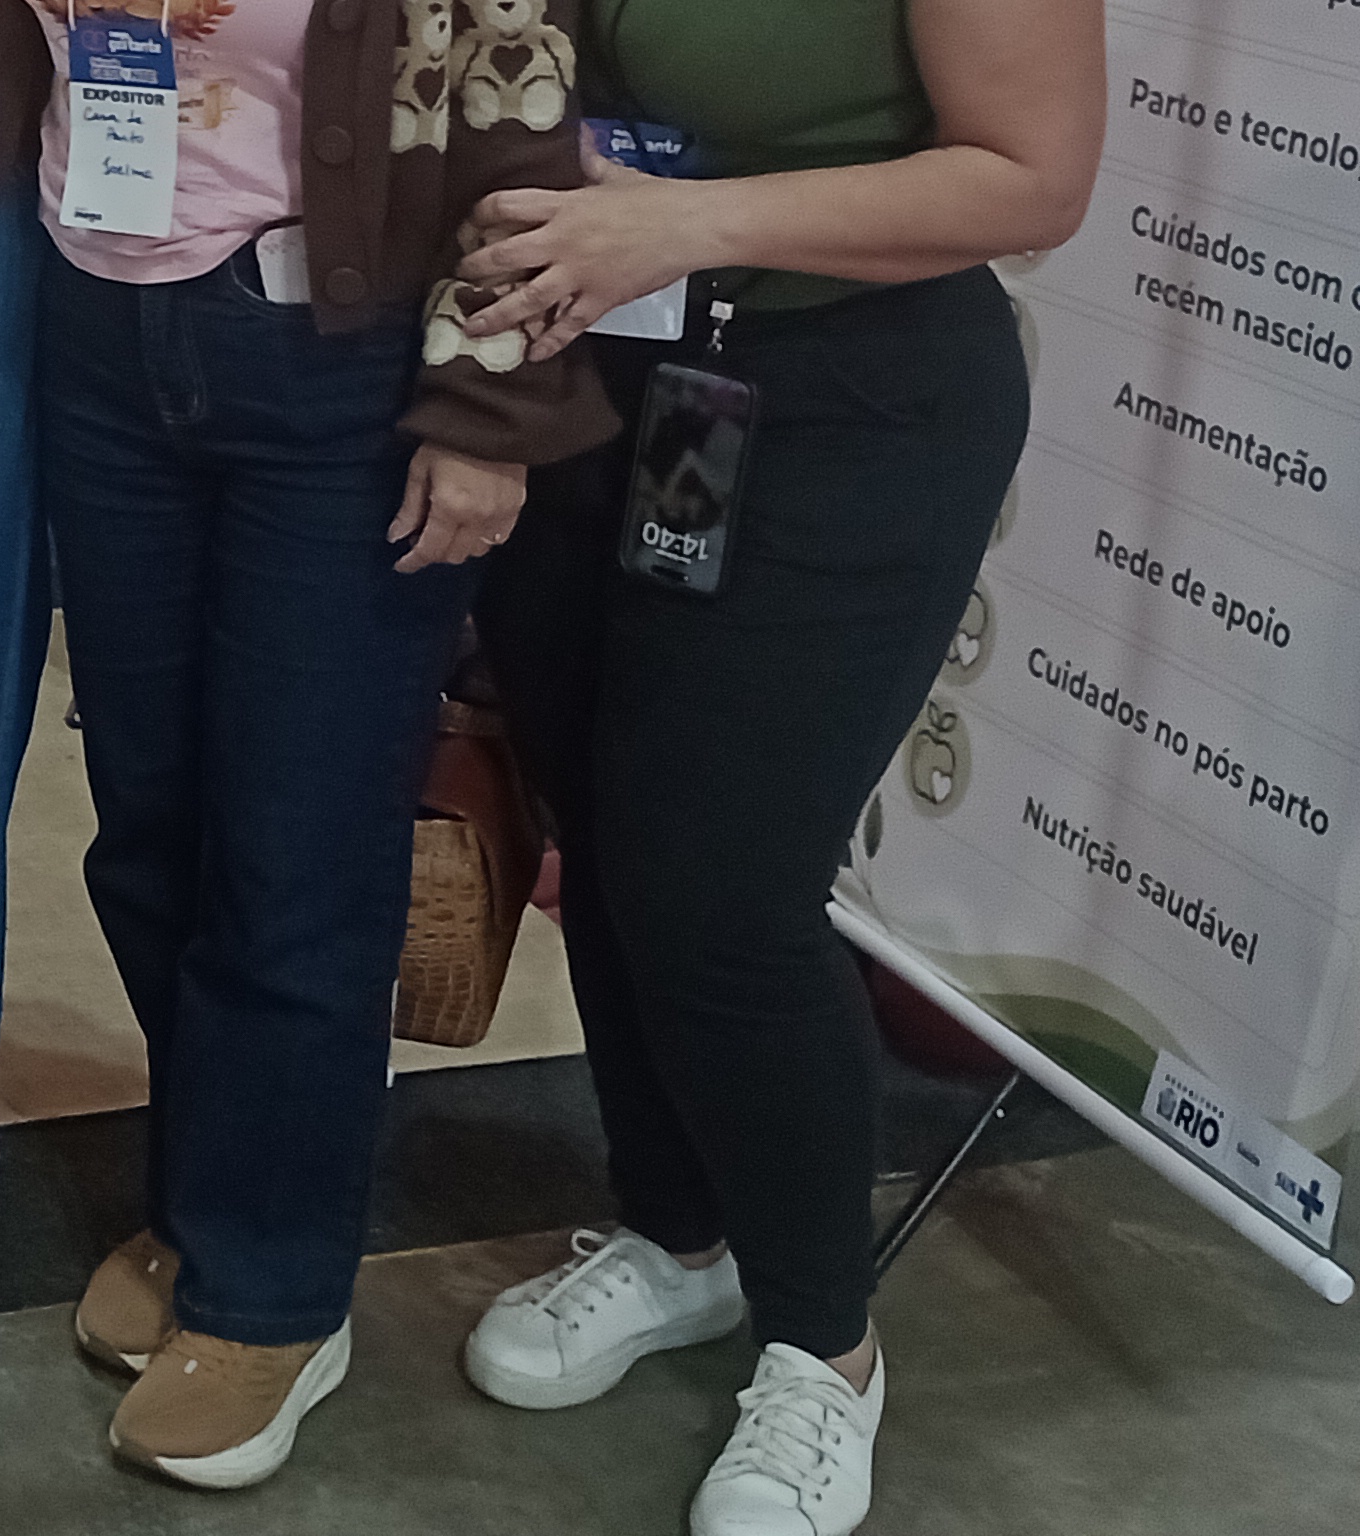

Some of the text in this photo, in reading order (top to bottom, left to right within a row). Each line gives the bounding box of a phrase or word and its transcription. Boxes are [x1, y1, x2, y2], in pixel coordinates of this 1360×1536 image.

[83, 88, 165, 105] EXPOSITOR
[1129, 77, 1360, 182] Parto e tecnolo
[1131, 204, 1266, 277] Cuidados
[1274, 258, 1342, 304] com
[1134, 272, 1353, 371] recém nascido
[1113, 382, 1328, 492] Amamentação
[642, 521, 709, 560] 14:40
[1094, 529, 1291, 648] Rede de apoio
[1028, 647, 1329, 836] Cuidados no pós parto
[1022, 795, 1259, 965] Nutrição saudável
[1174, 1097, 1219, 1148] RIO
